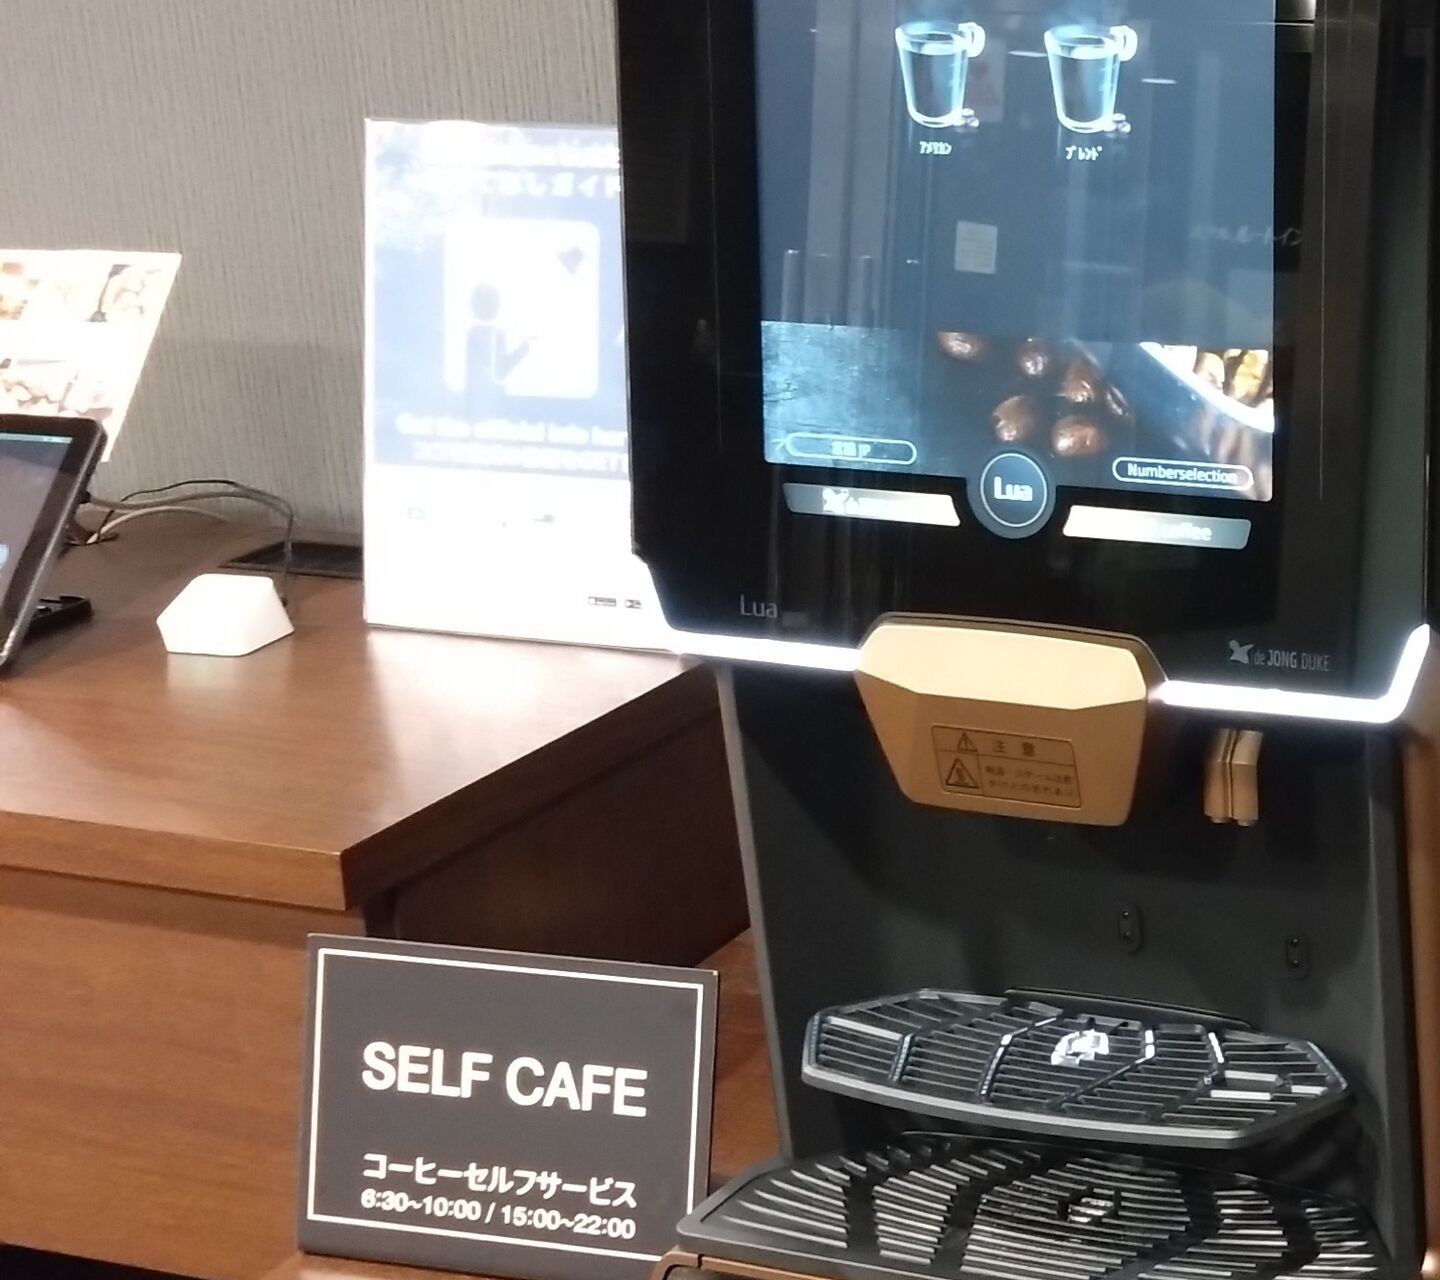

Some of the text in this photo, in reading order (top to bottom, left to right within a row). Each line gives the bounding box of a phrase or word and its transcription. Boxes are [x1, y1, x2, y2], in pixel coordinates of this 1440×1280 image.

[1127, 463, 1238, 485] Numberselection
[993, 476, 1034, 503] Lua
[739, 594, 778, 618] Lua
[1267, 649, 1297, 669] JONG
[1301, 653, 1330, 672] DUKE
[361, 1041, 648, 1118] SELF CAFE
[362, 1152, 637, 1209] コーヒーセルフサービス
